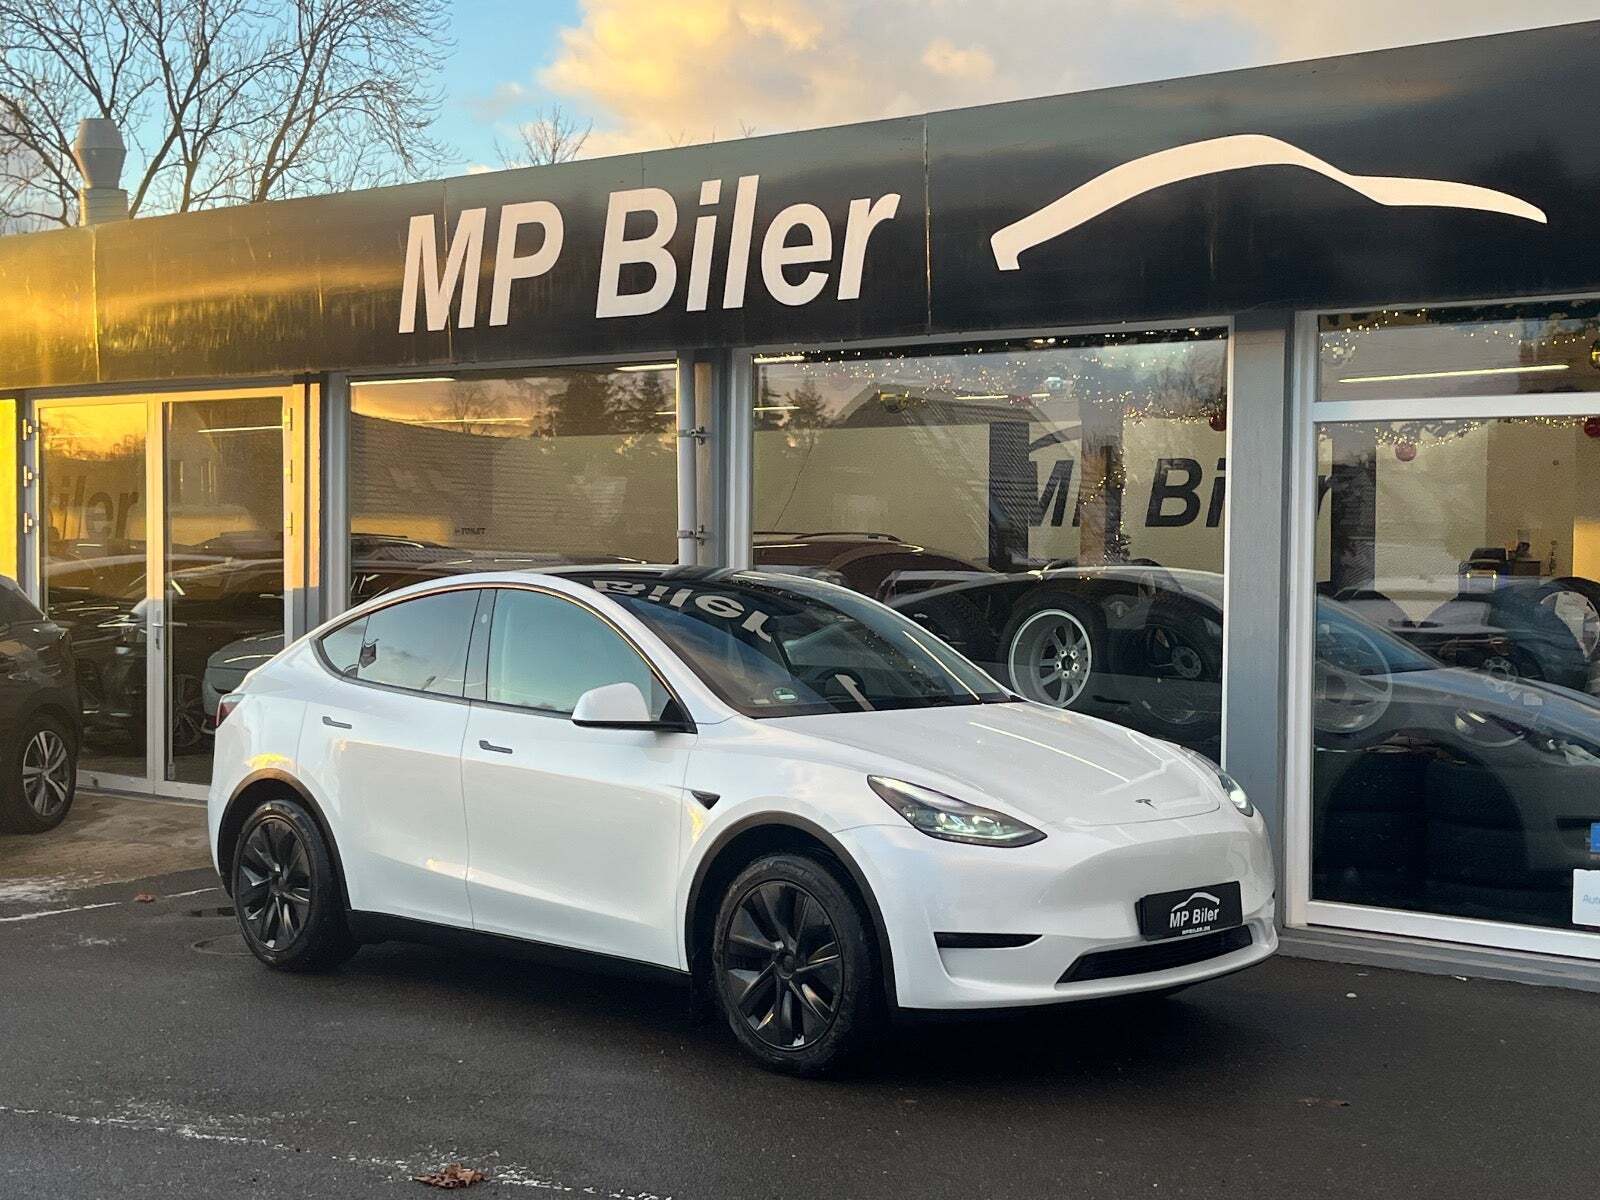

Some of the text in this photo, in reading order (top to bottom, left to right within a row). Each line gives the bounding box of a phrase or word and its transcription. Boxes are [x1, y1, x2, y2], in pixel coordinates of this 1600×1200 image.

[399, 175, 900, 333] MP Biler
[1170, 907, 1219, 928] MP Biler
